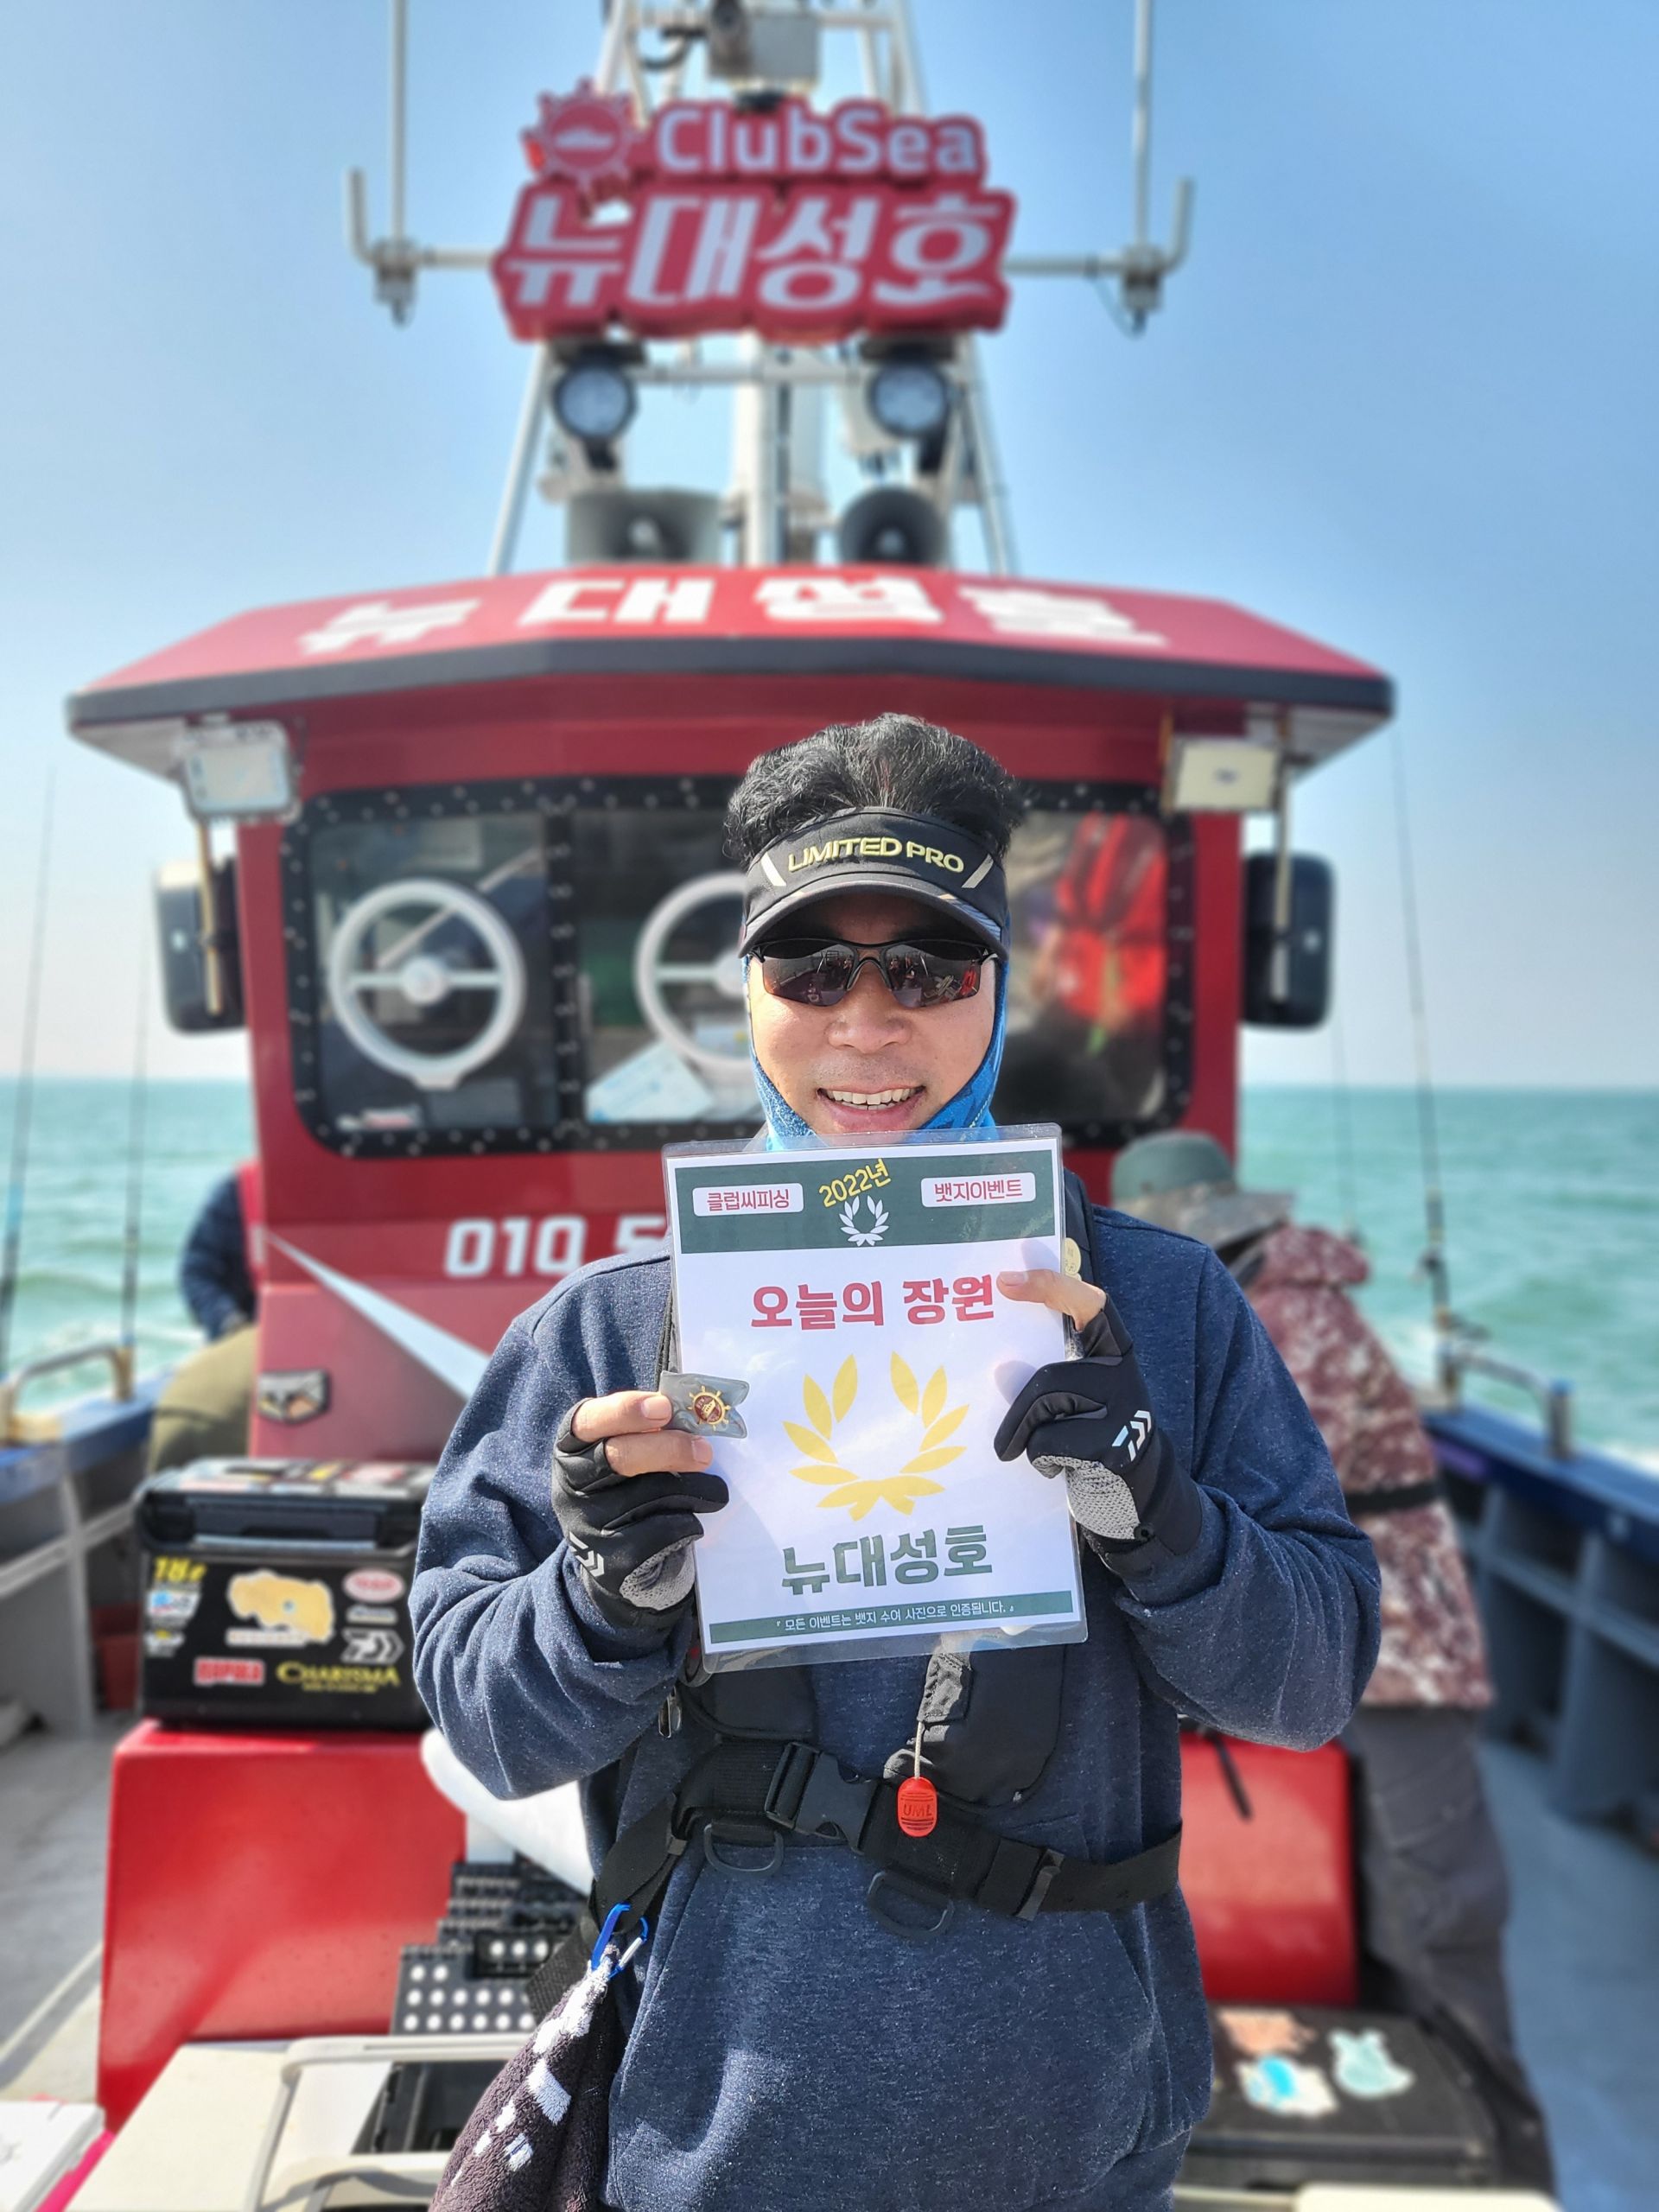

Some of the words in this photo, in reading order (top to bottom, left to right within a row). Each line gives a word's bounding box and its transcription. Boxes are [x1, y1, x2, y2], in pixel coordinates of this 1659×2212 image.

[656, 104, 978, 172] ClubSea
[506, 191, 1001, 310] 뉴대성호
[788, 836, 903, 872] LIMITED
[906, 841, 964, 874] PRO
[706, 1189, 791, 1211] 클럽씨피싱
[818, 1158, 893, 1208] 2022년
[934, 1178, 1024, 1203] 뱃지이벤트
[446, 1217, 586, 1276] 010
[750, 1280, 885, 1331] 오늘의
[902, 1274, 995, 1325] 장원
[781, 1525, 994, 1596] 뉴대성호
[785, 1618, 806, 1631] 모든
[810, 1615, 852, 1630] 이벤트는
[855, 1611, 877, 1624] 뱃지
[880, 1608, 902, 1623] 수여
[905, 1605, 948, 1620] 사진으로
[950, 1600, 1007, 1617] 인증됩니다.
